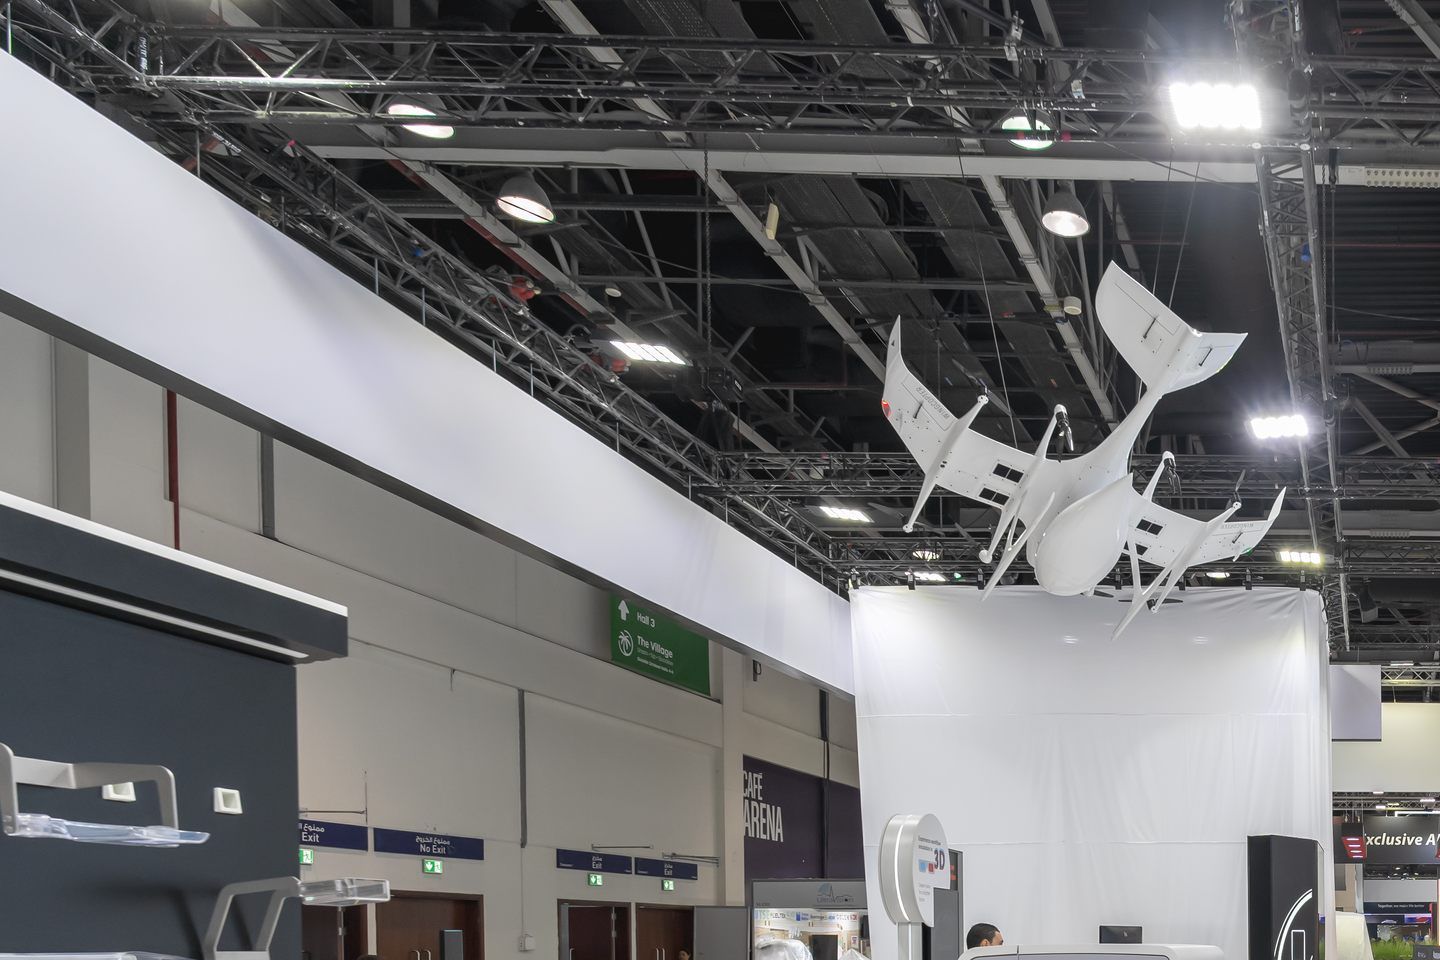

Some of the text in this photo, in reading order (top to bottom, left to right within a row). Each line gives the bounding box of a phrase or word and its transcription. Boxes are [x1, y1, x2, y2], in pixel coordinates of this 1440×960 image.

[637, 611, 656, 628] Hall 3
[637, 635, 650, 649] The
[650, 641, 673, 659] Village
[743, 799, 784, 843] ARENA
[302, 832, 320, 843] Exit
[1365, 833, 1423, 846] xclusive
[420, 844, 446, 855] No Exit
[934, 848, 945, 871] 3D
